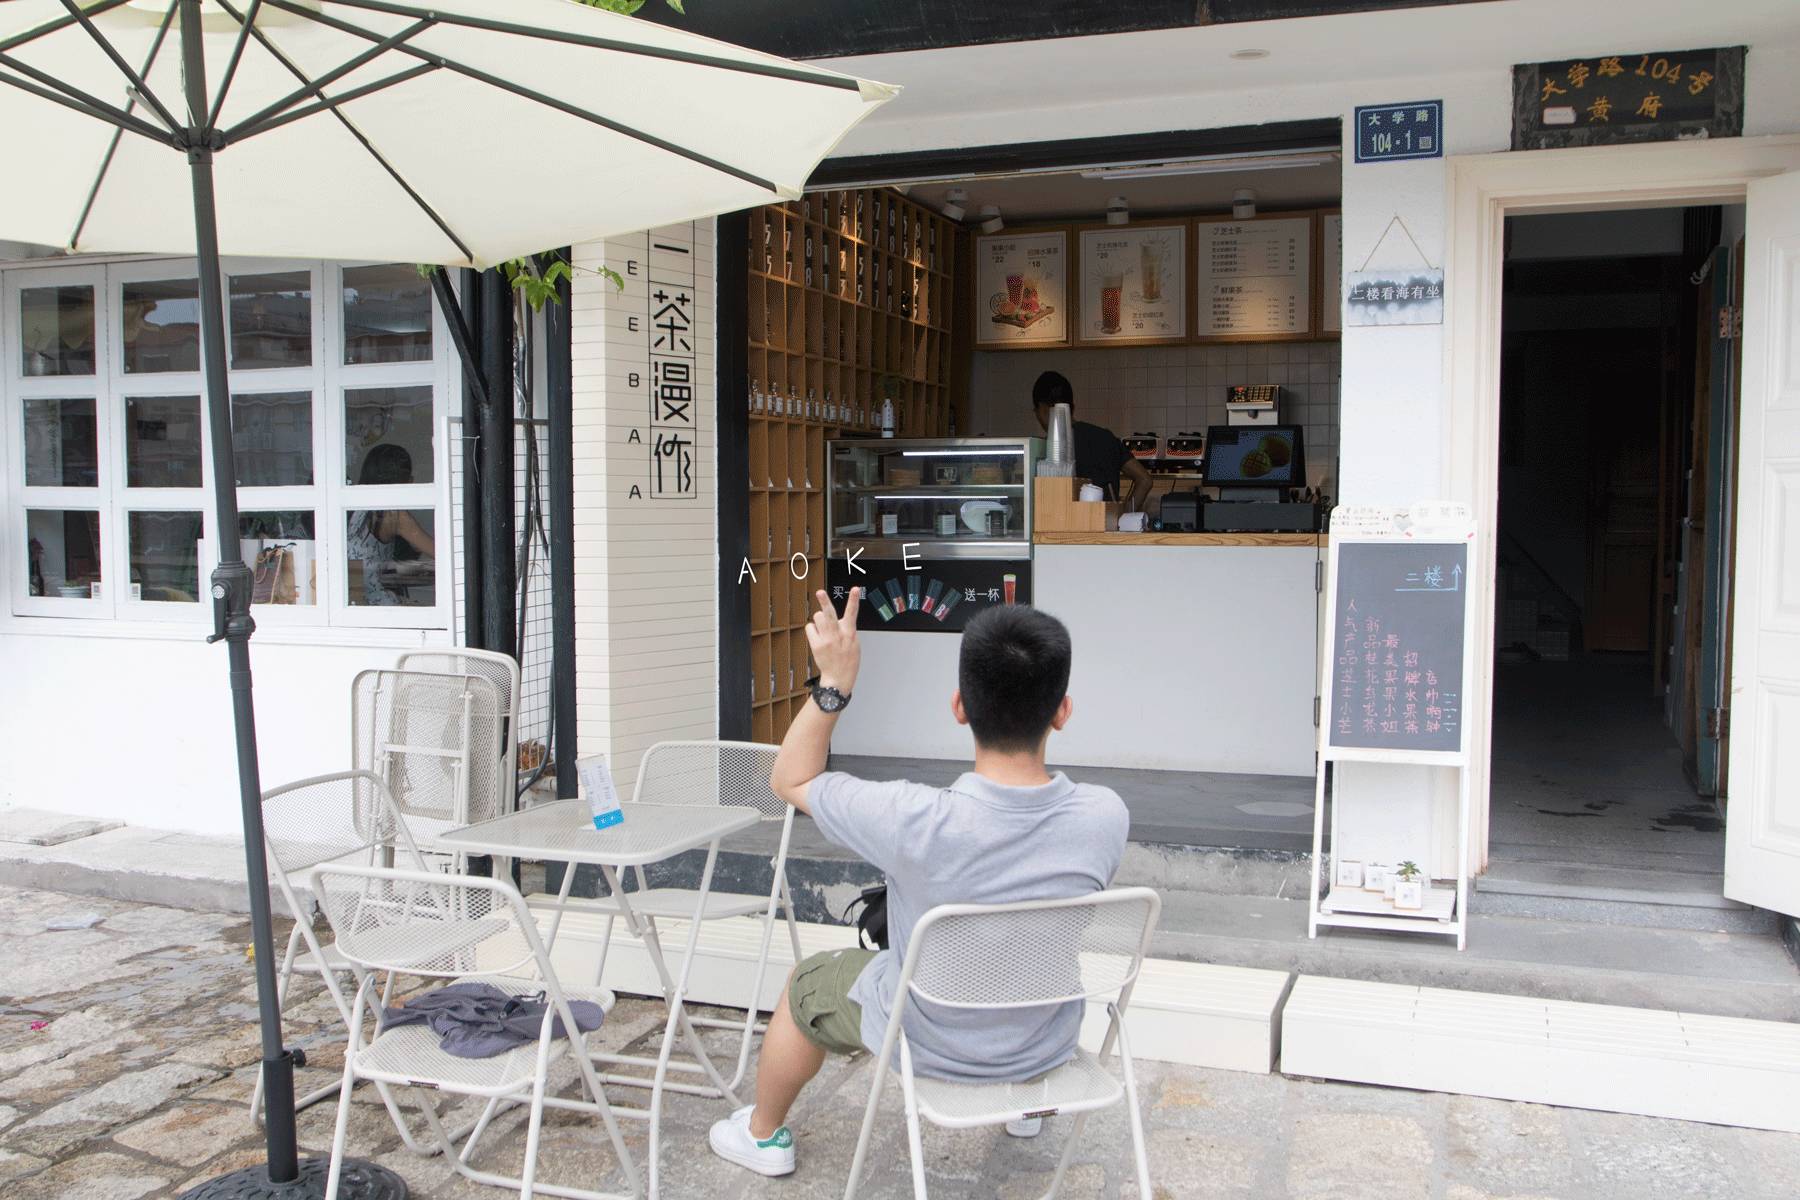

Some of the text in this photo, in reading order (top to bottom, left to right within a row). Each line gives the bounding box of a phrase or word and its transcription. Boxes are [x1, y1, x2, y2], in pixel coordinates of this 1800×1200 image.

[1368, 109, 1429, 126] 大学路
[1405, 565, 1444, 589] 二楼
[964, 587, 1000, 602] 送一杯
